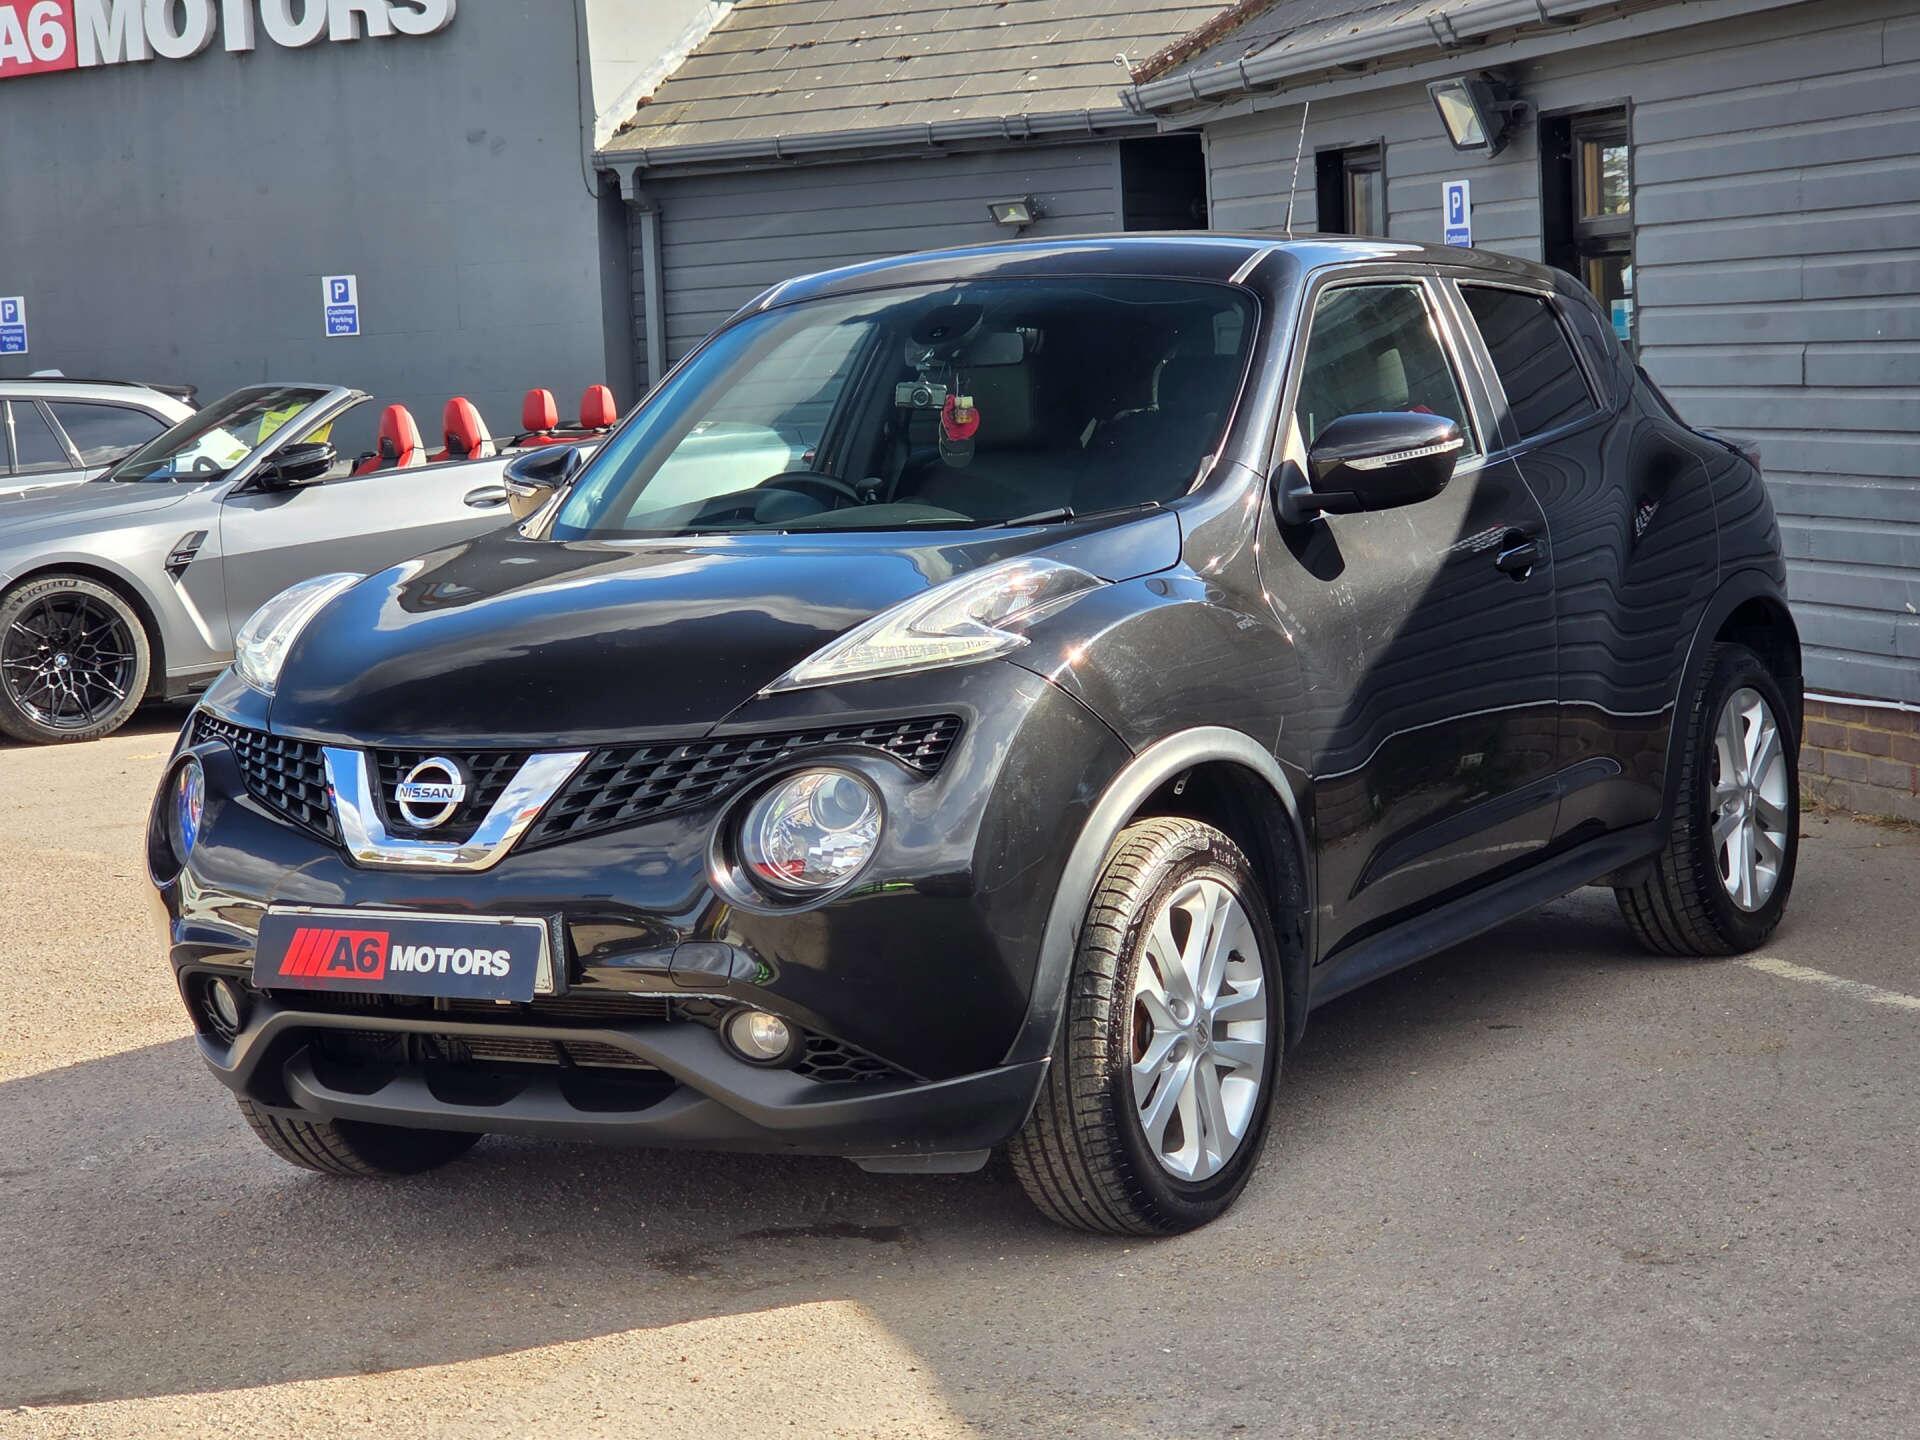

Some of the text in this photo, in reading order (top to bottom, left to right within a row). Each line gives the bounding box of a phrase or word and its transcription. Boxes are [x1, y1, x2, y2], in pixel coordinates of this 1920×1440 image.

[0, 1, 67, 66] A6
[1452, 192, 1461, 218] P
[334, 283, 345, 300] P
[5, 303, 15, 320] P
[400, 787, 454, 799] NISSAN
[327, 936, 511, 977] A6 MOTORS
